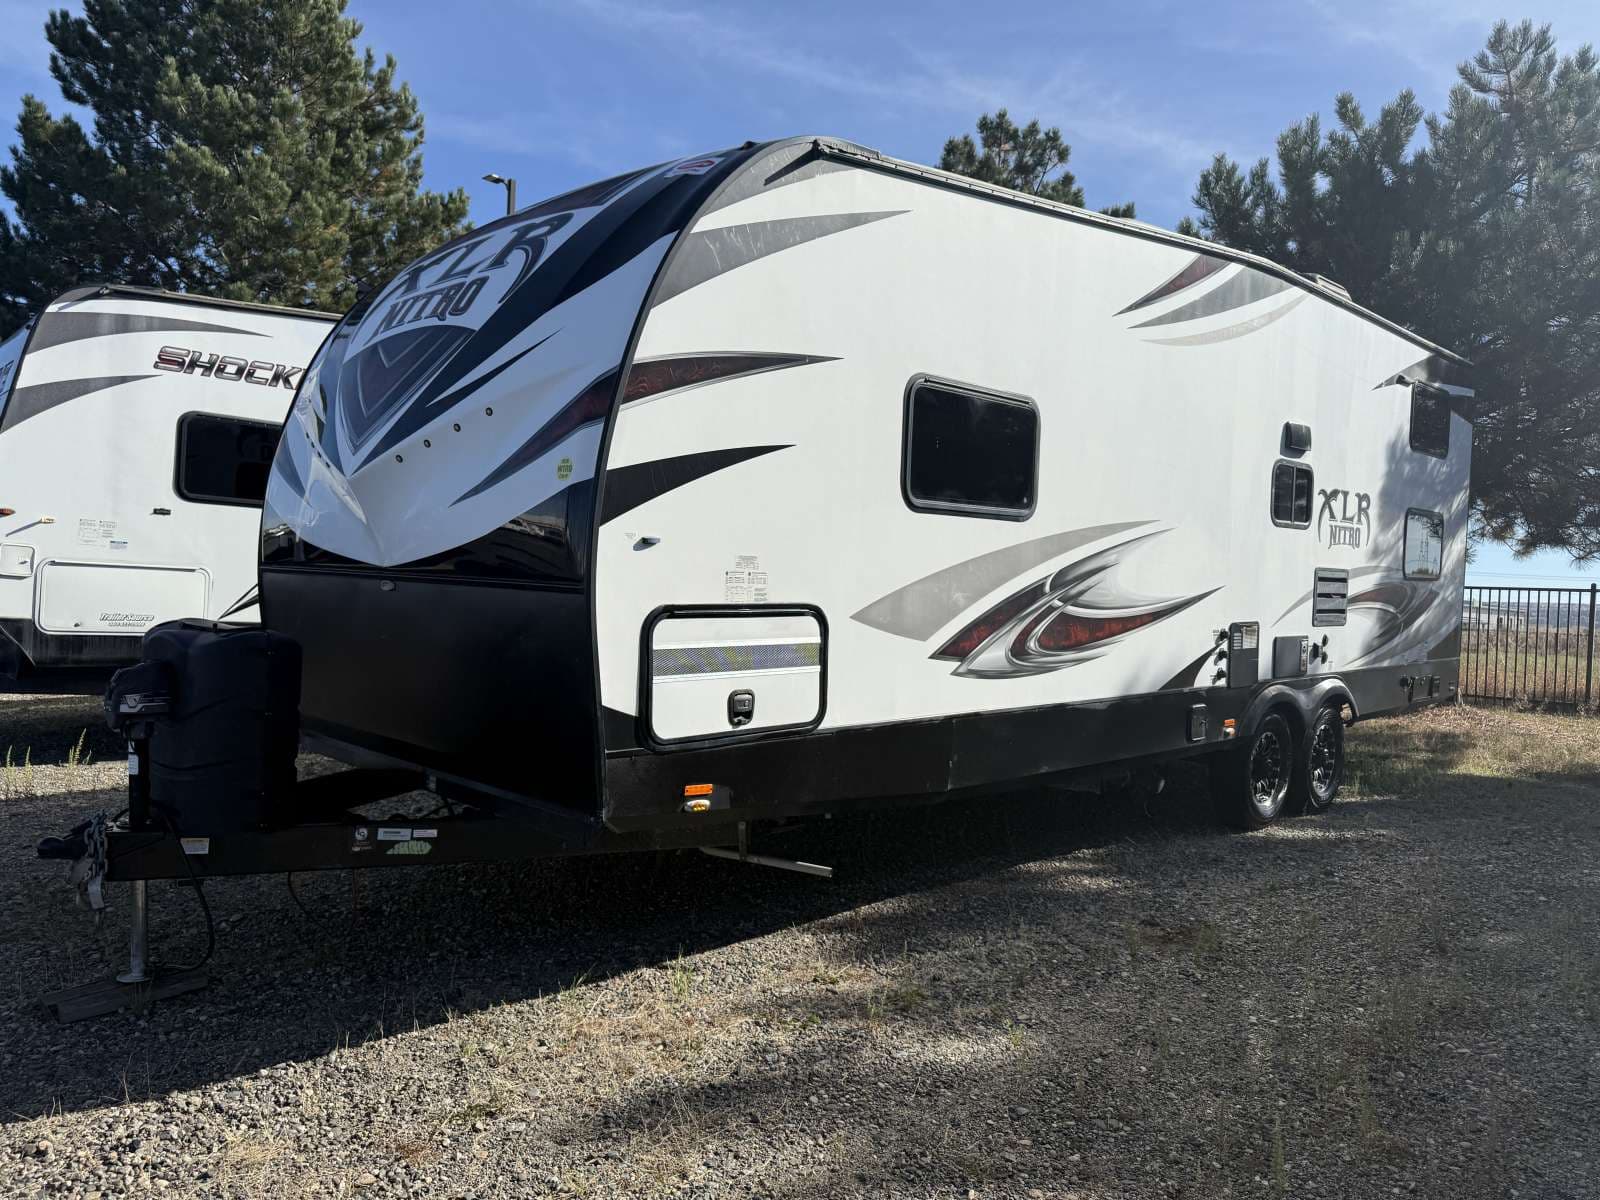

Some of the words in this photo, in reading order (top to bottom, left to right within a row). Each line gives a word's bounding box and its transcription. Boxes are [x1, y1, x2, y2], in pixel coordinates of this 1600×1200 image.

[351, 211, 574, 344] XLR
[364, 275, 490, 345] NITRO
[153, 345, 307, 390] SHOCK
[1317, 488, 1371, 548] XLR
[1327, 524, 1361, 550] NITRO
